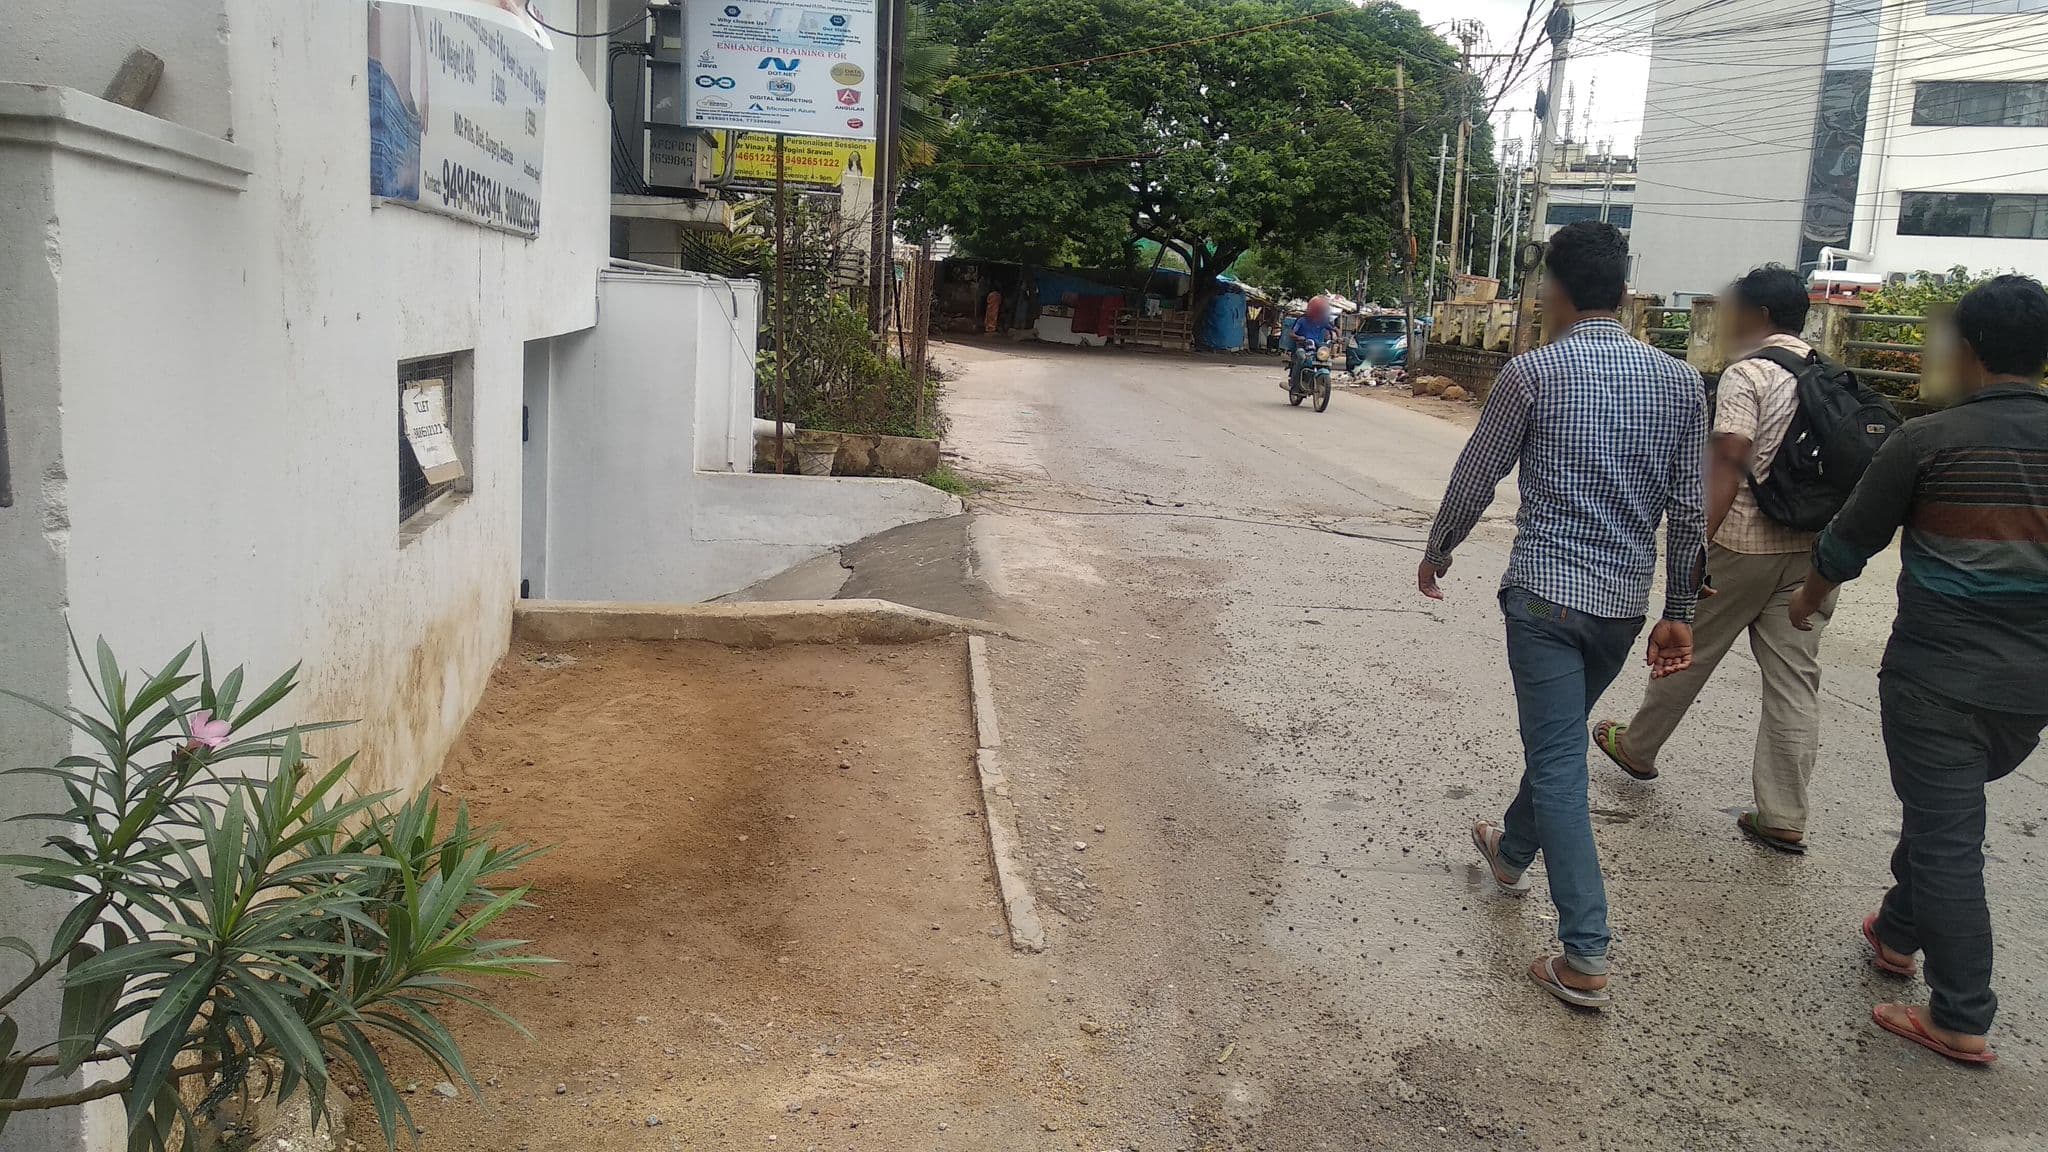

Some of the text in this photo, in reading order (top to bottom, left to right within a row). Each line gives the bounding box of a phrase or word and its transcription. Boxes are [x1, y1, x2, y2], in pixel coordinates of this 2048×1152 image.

[717, 42, 847, 60] ENHANCED TRAINING FOR
[776, 96, 813, 104] MARKETING
[745, 142, 766, 152] Vinay
[806, 147, 834, 156] Sravani
[786, 137, 833, 147] Personalised
[834, 141, 867, 150] Sessions
[785, 155, 840, 167] 9492651222
